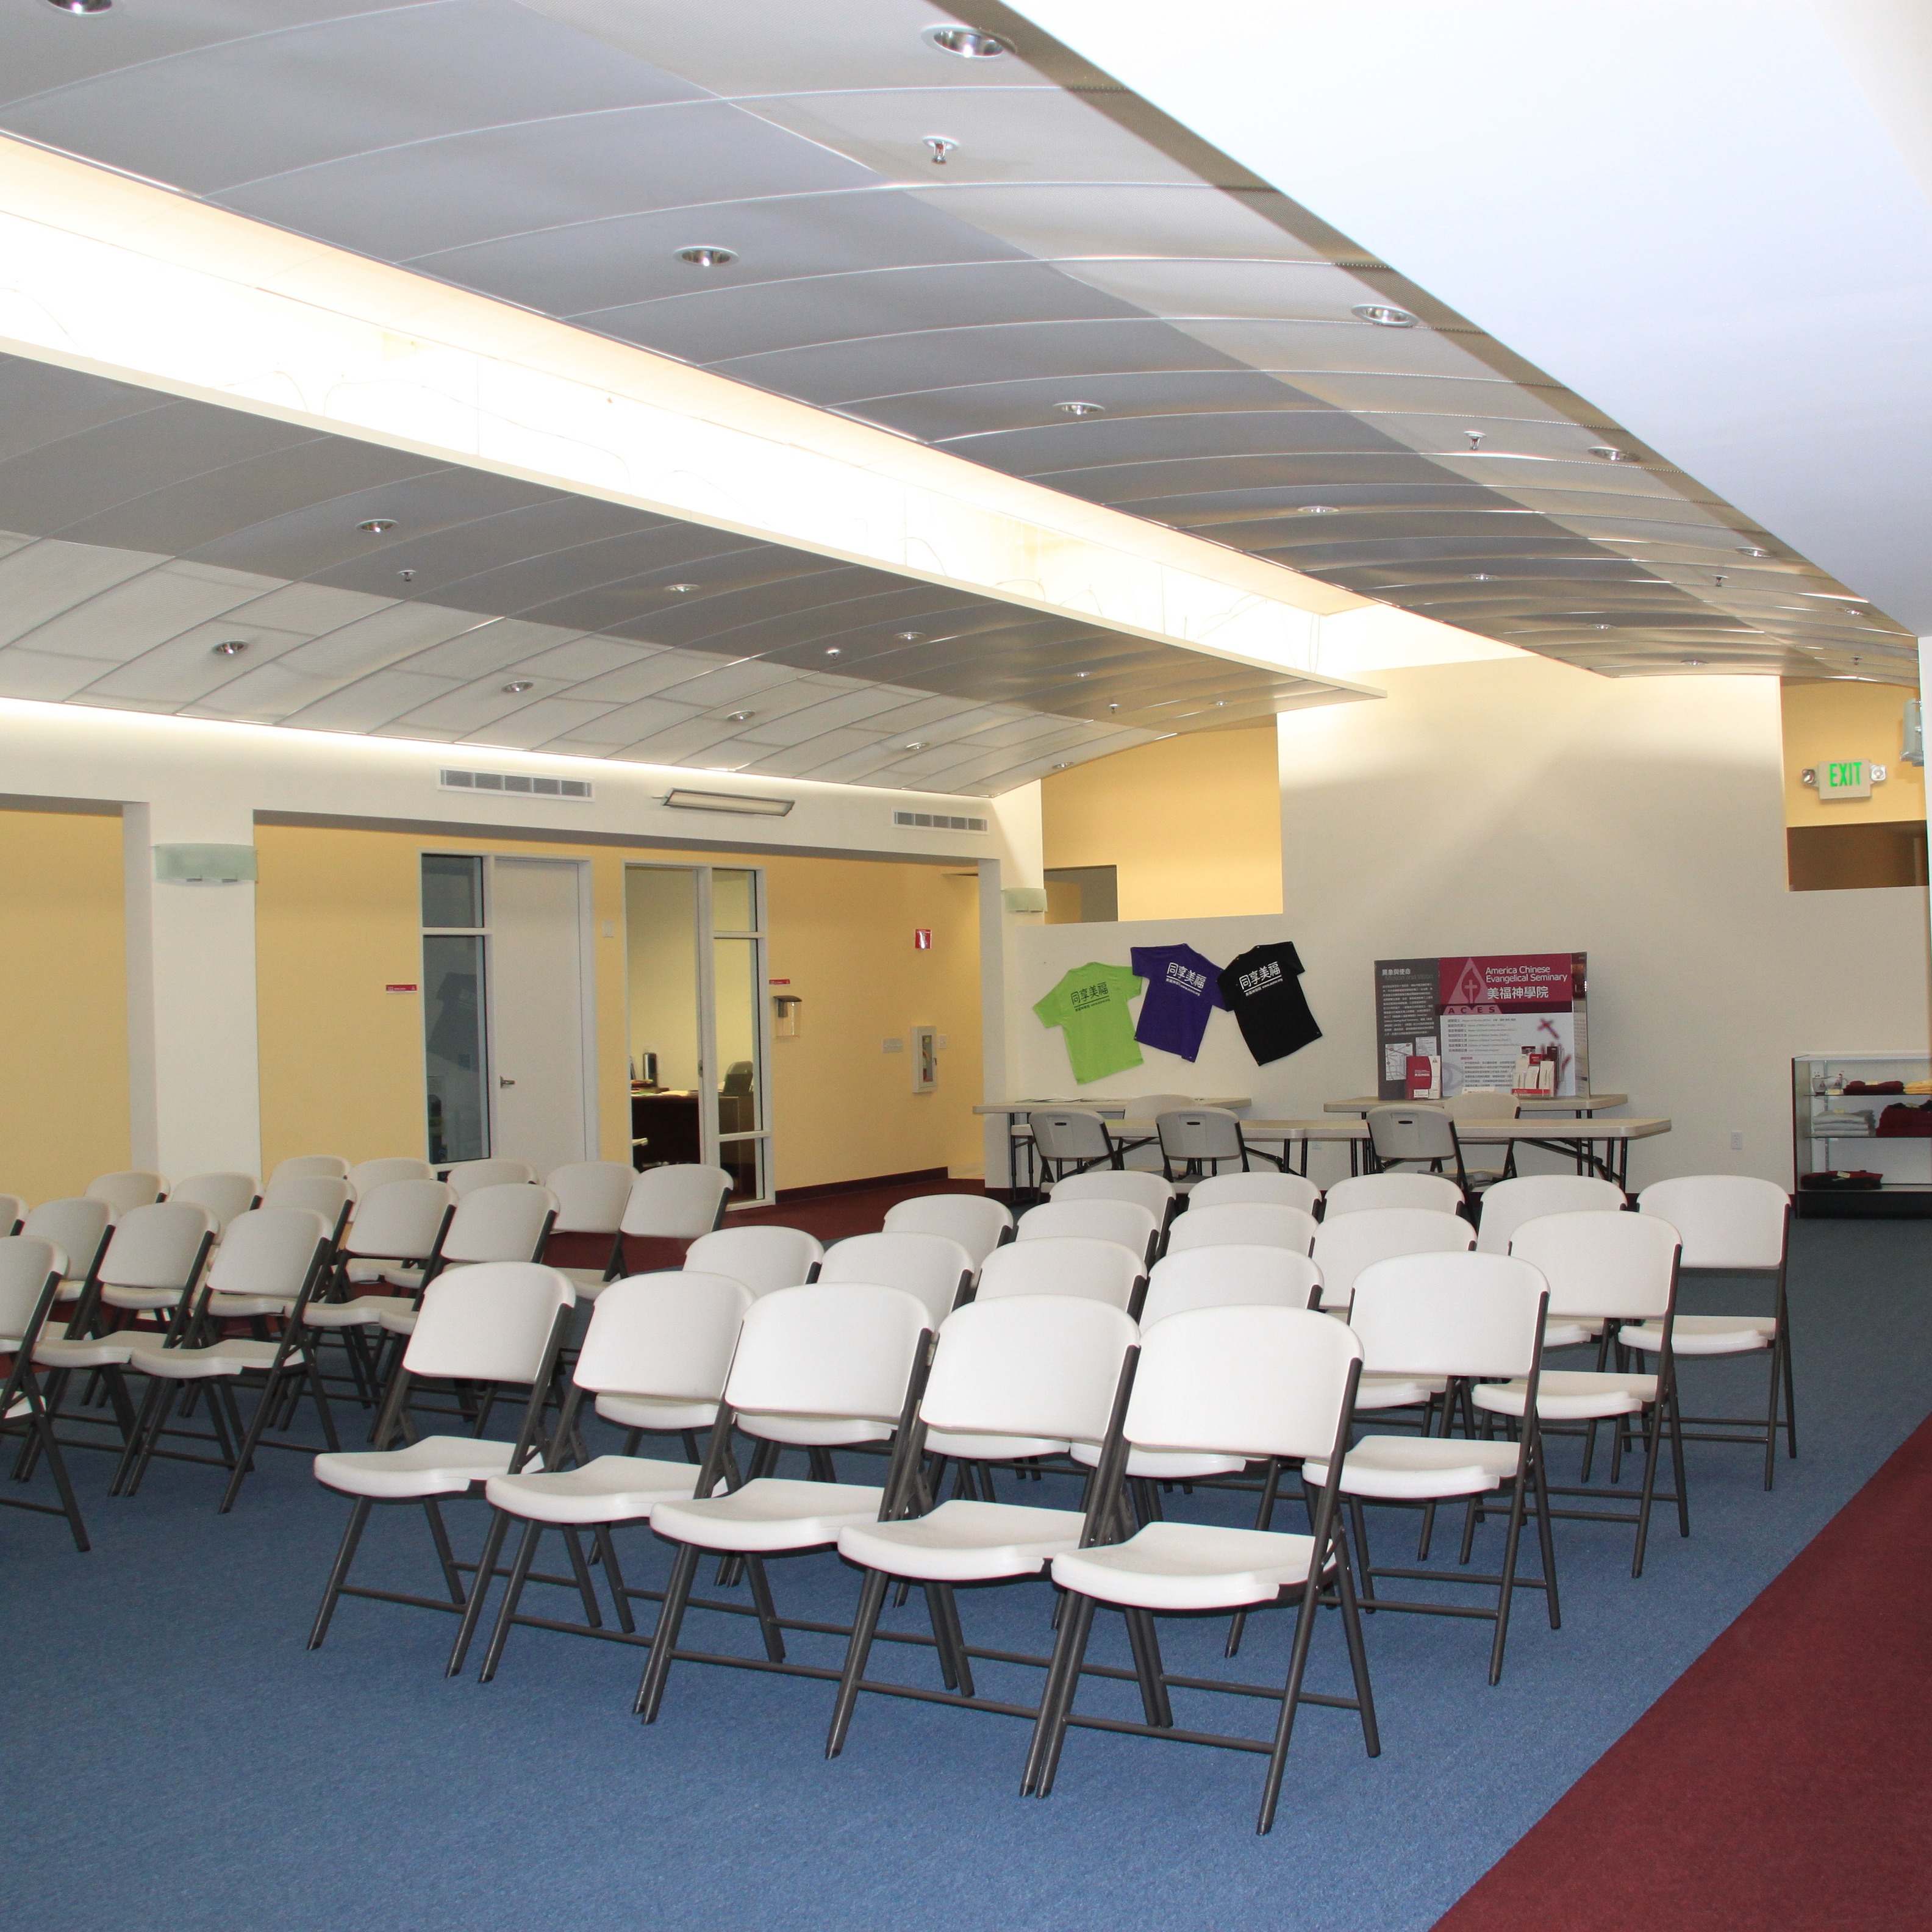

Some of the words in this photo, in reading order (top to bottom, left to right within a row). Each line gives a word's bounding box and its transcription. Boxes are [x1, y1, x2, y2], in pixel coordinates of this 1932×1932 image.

[1829, 762, 1862, 787] EXIT
[1167, 962, 1207, 989] 同享美福
[1239, 961, 1281, 990] 同享美福
[1486, 974, 1528, 984] Evangelical
[1530, 973, 1567, 982] Seminary
[1519, 965, 1550, 974] Chinese
[1071, 982, 1109, 1005] 同享美福
[1487, 986, 1549, 1000] 美福神學院
